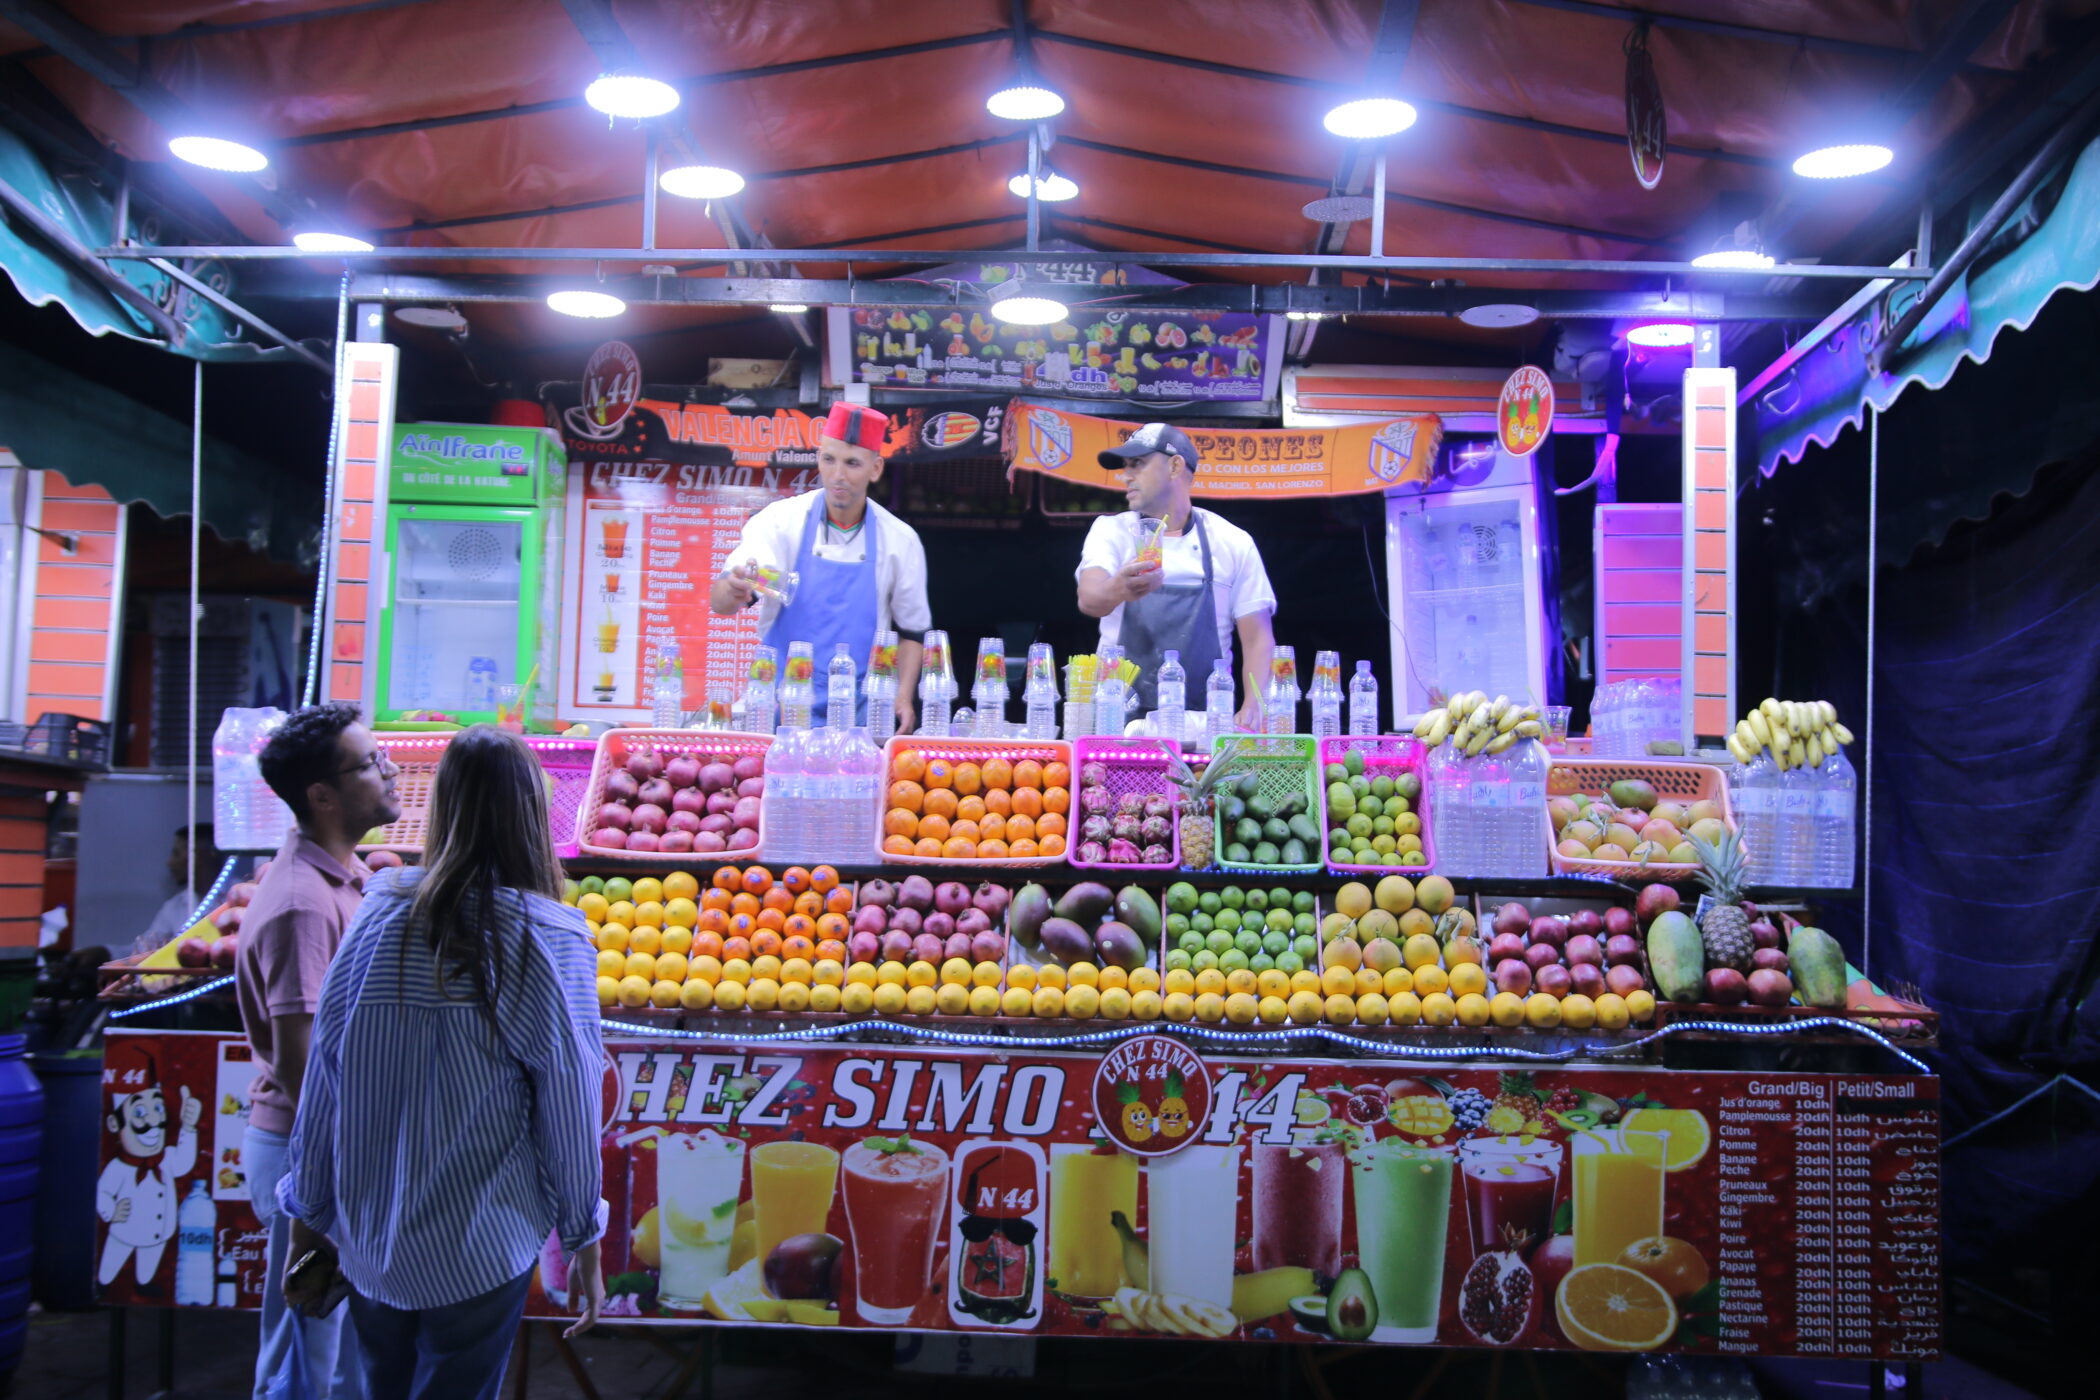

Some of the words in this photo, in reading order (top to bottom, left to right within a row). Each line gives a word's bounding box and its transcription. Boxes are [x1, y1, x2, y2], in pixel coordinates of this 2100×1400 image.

[606, 371, 636, 407] 44
[660, 408, 806, 448] VALENCIA
[983, 405, 1004, 447] VCF
[566, 440, 629, 455] TOYOTA
[731, 448, 775, 463] Amunt
[776, 450, 820, 463] Valenci
[1216, 463, 1241, 473] CON
[1244, 463, 1267, 474] LOS
[1270, 462, 1324, 474] MEJORES
[590, 461, 671, 489] CHEZ
[676, 464, 753, 492] SIMO
[761, 466, 783, 493] N
[1256, 480, 1275, 489] SAN
[1277, 479, 1324, 490] LORENZO
[651, 515, 710, 526] Pamplemousse
[650, 527, 677, 536] Citron
[650, 538, 681, 548] Pomme
[649, 549, 681, 559] Banane
[648, 570, 689, 580] Pruneaux
[647, 580, 695, 591] Gingembre
[646, 612, 670, 622] Poire
[707, 617, 736, 626] 20dh
[645, 624, 675, 634] Avocat
[707, 629, 735, 638] 20dh
[706, 641, 735, 650] 20dh
[706, 650, 734, 660] 20dh
[705, 660, 734, 669] 20dh
[1102, 1040, 1146, 1085] CHEZ
[1151, 1040, 1198, 1079] SIMO
[102, 1068, 117, 1084] N
[122, 1068, 147, 1084] 44
[1126, 1065, 1140, 1083] N
[1145, 1062, 1169, 1080] 44
[617, 1052, 804, 1127] HEZ
[822, 1058, 1066, 1136] SIMO
[1748, 1081, 1825, 1098] Grand/Big
[1838, 1081, 1915, 1098] Petit/Small
[1719, 1097, 1735, 1108] Jus
[1738, 1097, 1781, 1110] d'orange
[1795, 1100, 1830, 1110] 10dh
[1719, 1111, 1791, 1123] Pamplemousse
[1796, 1113, 1830, 1123] 20dh
[1719, 1126, 1750, 1137] Citron
[1796, 1127, 1830, 1137] 20dh
[1836, 1128, 1871, 1138] 10dh
[1719, 1140, 1757, 1150] Pomme
[1796, 1141, 1830, 1151] 20dh
[1836, 1141, 1871, 1152] 10dh
[1719, 1154, 1757, 1164] Banane
[1796, 1155, 1830, 1166] 20dh
[1836, 1156, 1871, 1166] 10dh
[1719, 1165, 1751, 1175] Peche
[1796, 1167, 1830, 1177] 20dh
[1836, 1167, 1871, 1178] 10dh
[1719, 1180, 1768, 1190] Pruneaux
[1796, 1181, 1830, 1191] 20dh
[1836, 1181, 1871, 1192] 10dh
[977, 1186, 998, 1208] N
[1002, 1187, 1034, 1209] 44
[1719, 1193, 1775, 1205] Gingembre
[1796, 1196, 1830, 1206] 20dh
[1836, 1197, 1871, 1207] 10dh
[1719, 1205, 1742, 1216] Kaki
[1796, 1210, 1830, 1221] 20dh
[1836, 1210, 1871, 1221] 10dh
[1719, 1218, 1742, 1229] Kiwi
[1796, 1224, 1830, 1234] 20dh
[1836, 1224, 1871, 1235] 10dh
[1719, 1234, 1746, 1245] Poire
[1796, 1237, 1830, 1248] 20dh
[1836, 1238, 1871, 1249] 10dh
[231, 1245, 259, 1260] Eau
[1719, 1248, 1755, 1259] Avocat
[1796, 1252, 1830, 1263] 20dh
[1836, 1253, 1871, 1264] 10dh
[1719, 1261, 1757, 1273] Papaye
[1796, 1267, 1830, 1278] 20dh
[1836, 1268, 1871, 1279] 10dh
[1719, 1276, 1757, 1287] Ananas
[1796, 1279, 1830, 1290] 20dh
[1836, 1280, 1871, 1291] 10dh
[1719, 1288, 1762, 1299] Grenade
[1796, 1292, 1830, 1302] 20dh
[1836, 1292, 1871, 1303] 10dh
[1719, 1300, 1763, 1313] Pastique
[1796, 1303, 1830, 1314] 20dh
[1836, 1304, 1871, 1315] 10dh
[1719, 1313, 1768, 1324] Nectarine
[1796, 1316, 1830, 1327] 20dh
[1836, 1317, 1871, 1328] 10dh
[1719, 1327, 1750, 1338] Fraise
[1796, 1328, 1830, 1339] 20dh
[1836, 1328, 1871, 1339] 10dh
[1719, 1340, 1760, 1354] Mangue
[1796, 1342, 1830, 1353] 20dh
[1836, 1343, 1871, 1354] 10dh
